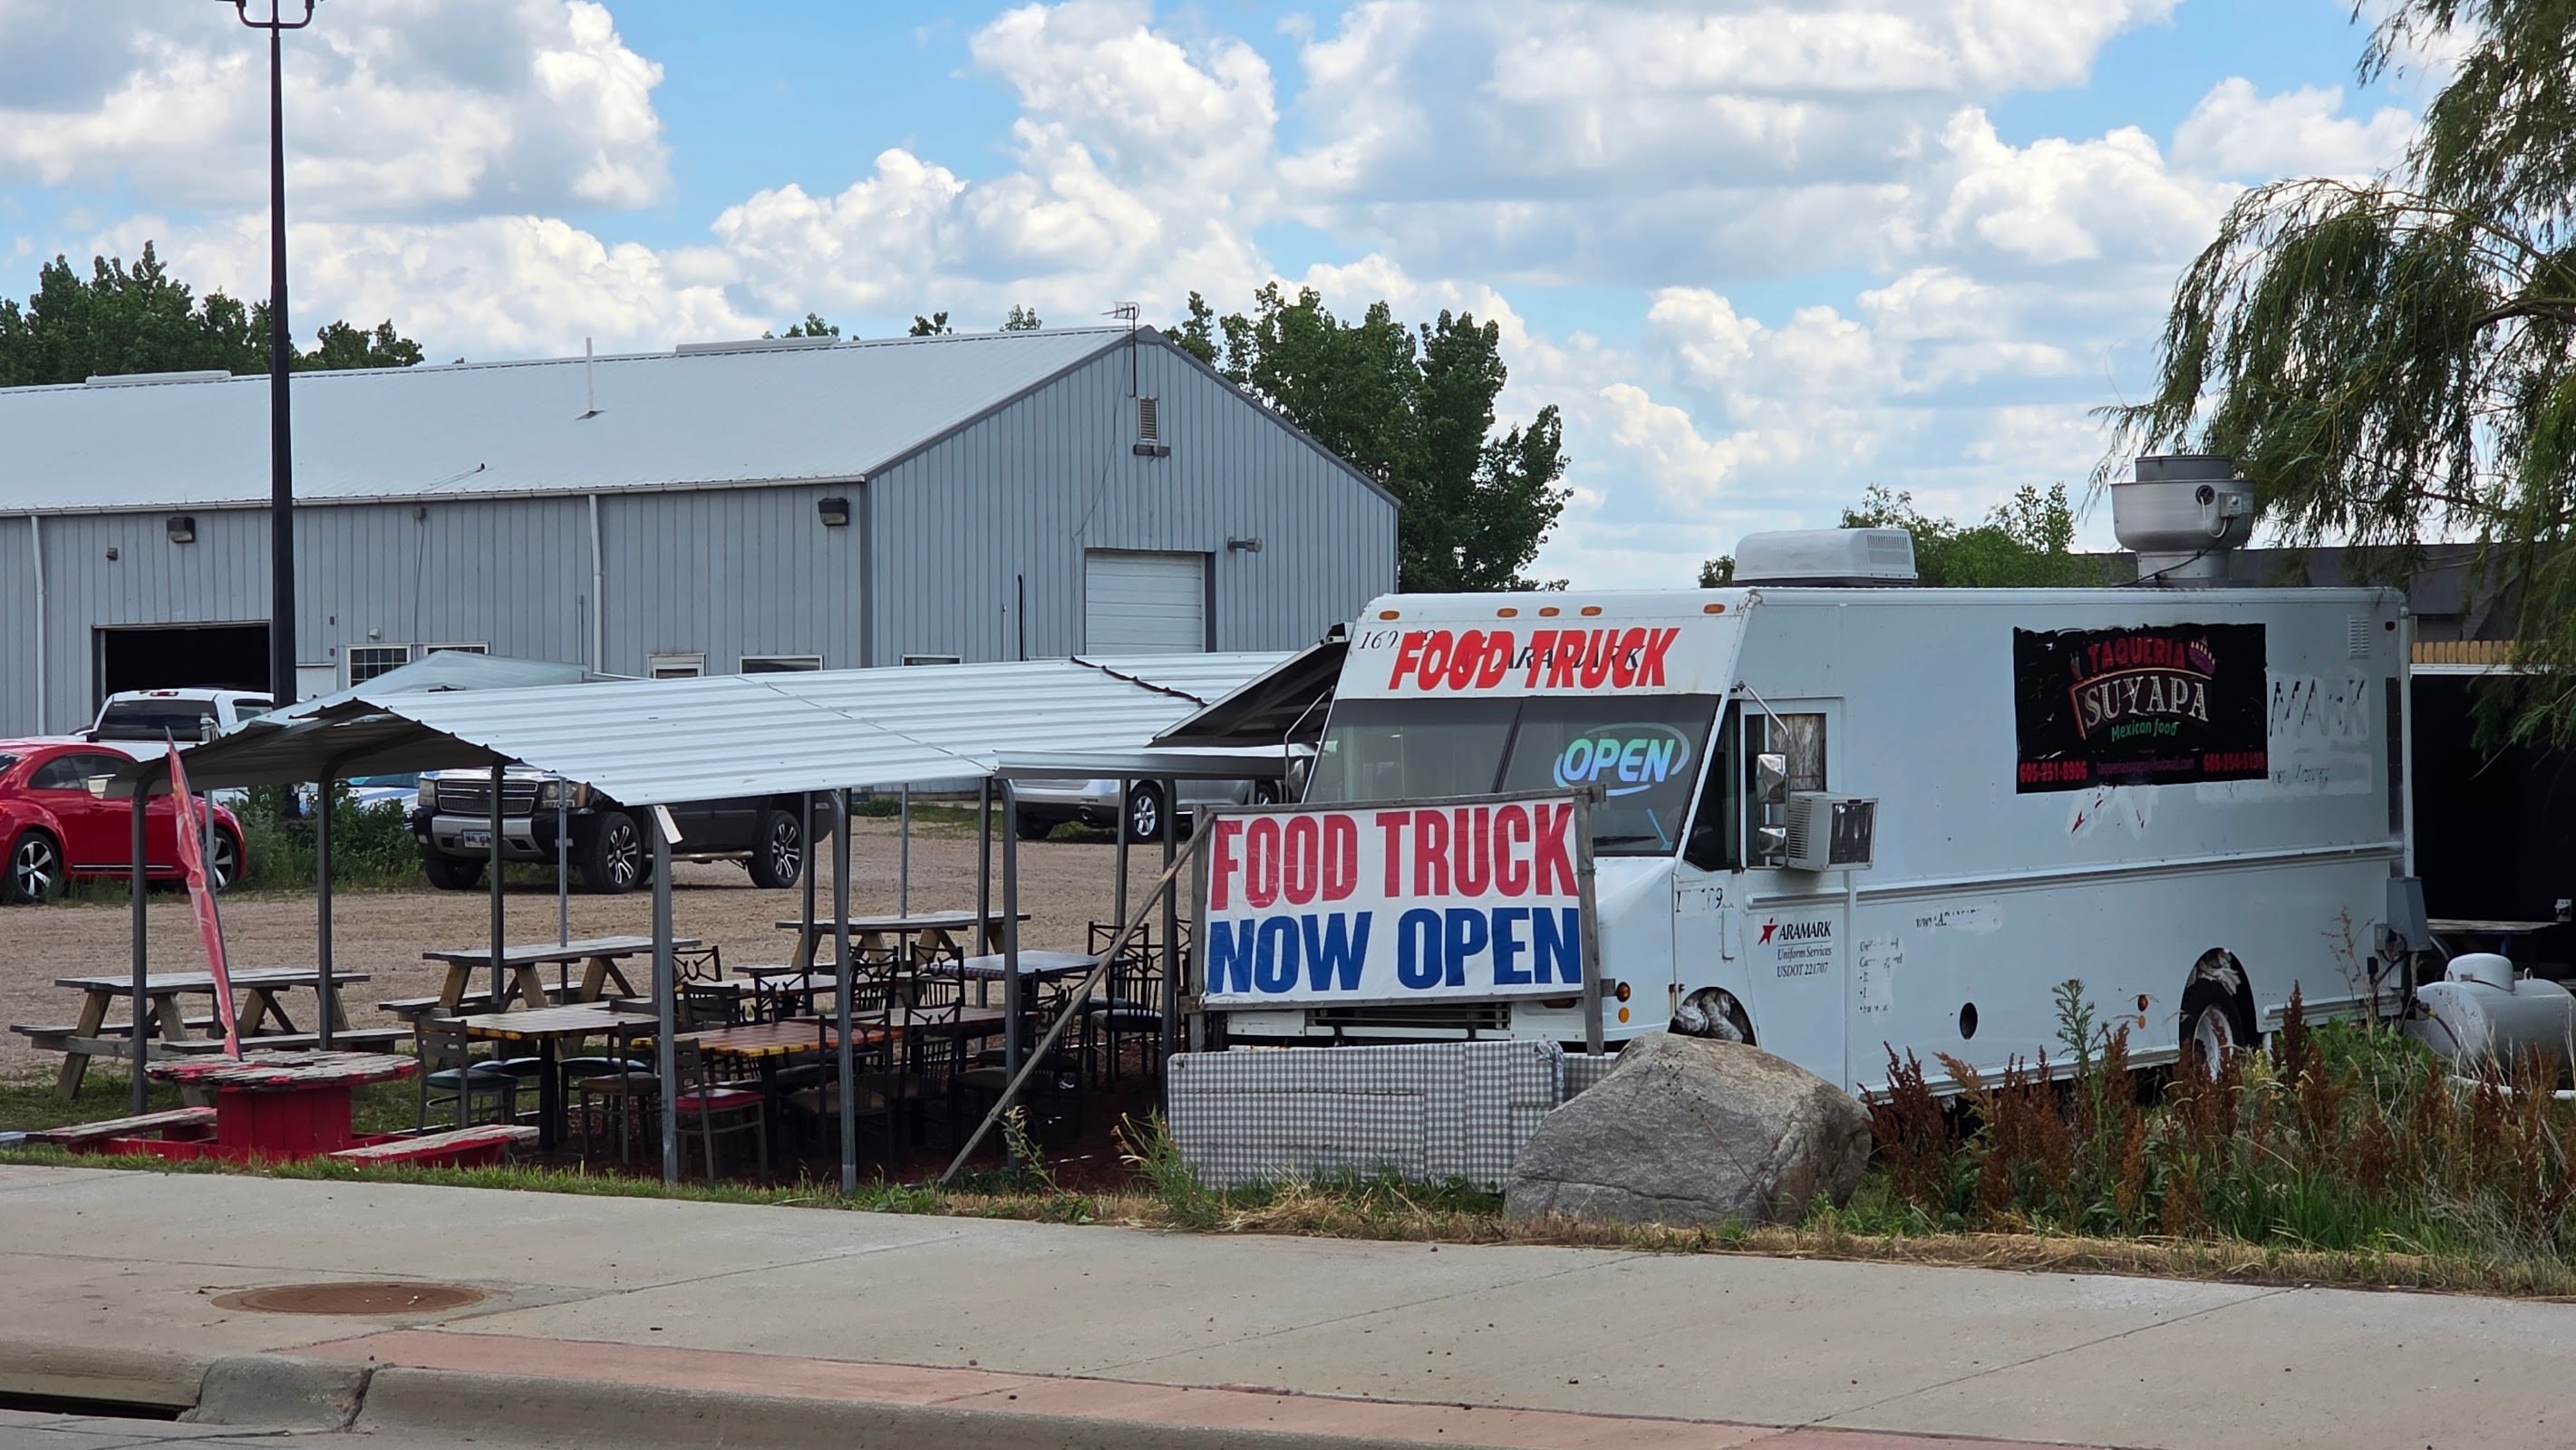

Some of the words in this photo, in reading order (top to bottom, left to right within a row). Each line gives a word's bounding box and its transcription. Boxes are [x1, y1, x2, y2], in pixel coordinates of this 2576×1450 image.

[1389, 629, 1515, 691] FOOD
[1525, 626, 1680, 689] TRUCK
[2087, 637, 2185, 672] TAQUERIA
[2085, 675, 2209, 730] SUYAPA
[2111, 720, 2152, 742] Mexican
[2153, 718, 2180, 737] food
[1562, 738, 1675, 783] OPEN
[1210, 814, 1358, 911] FOOD
[1376, 803, 1580, 897] TRUCK
[1207, 911, 1372, 993] NOW
[1397, 907, 1581, 986] OPEN
[1777, 921, 1832, 941] ARAMARK
[1777, 947, 1806, 962] Uniform
[1806, 944, 1832, 958] Services
[1777, 963, 1804, 978] USDOT
[1805, 962, 1828, 975] 221707
